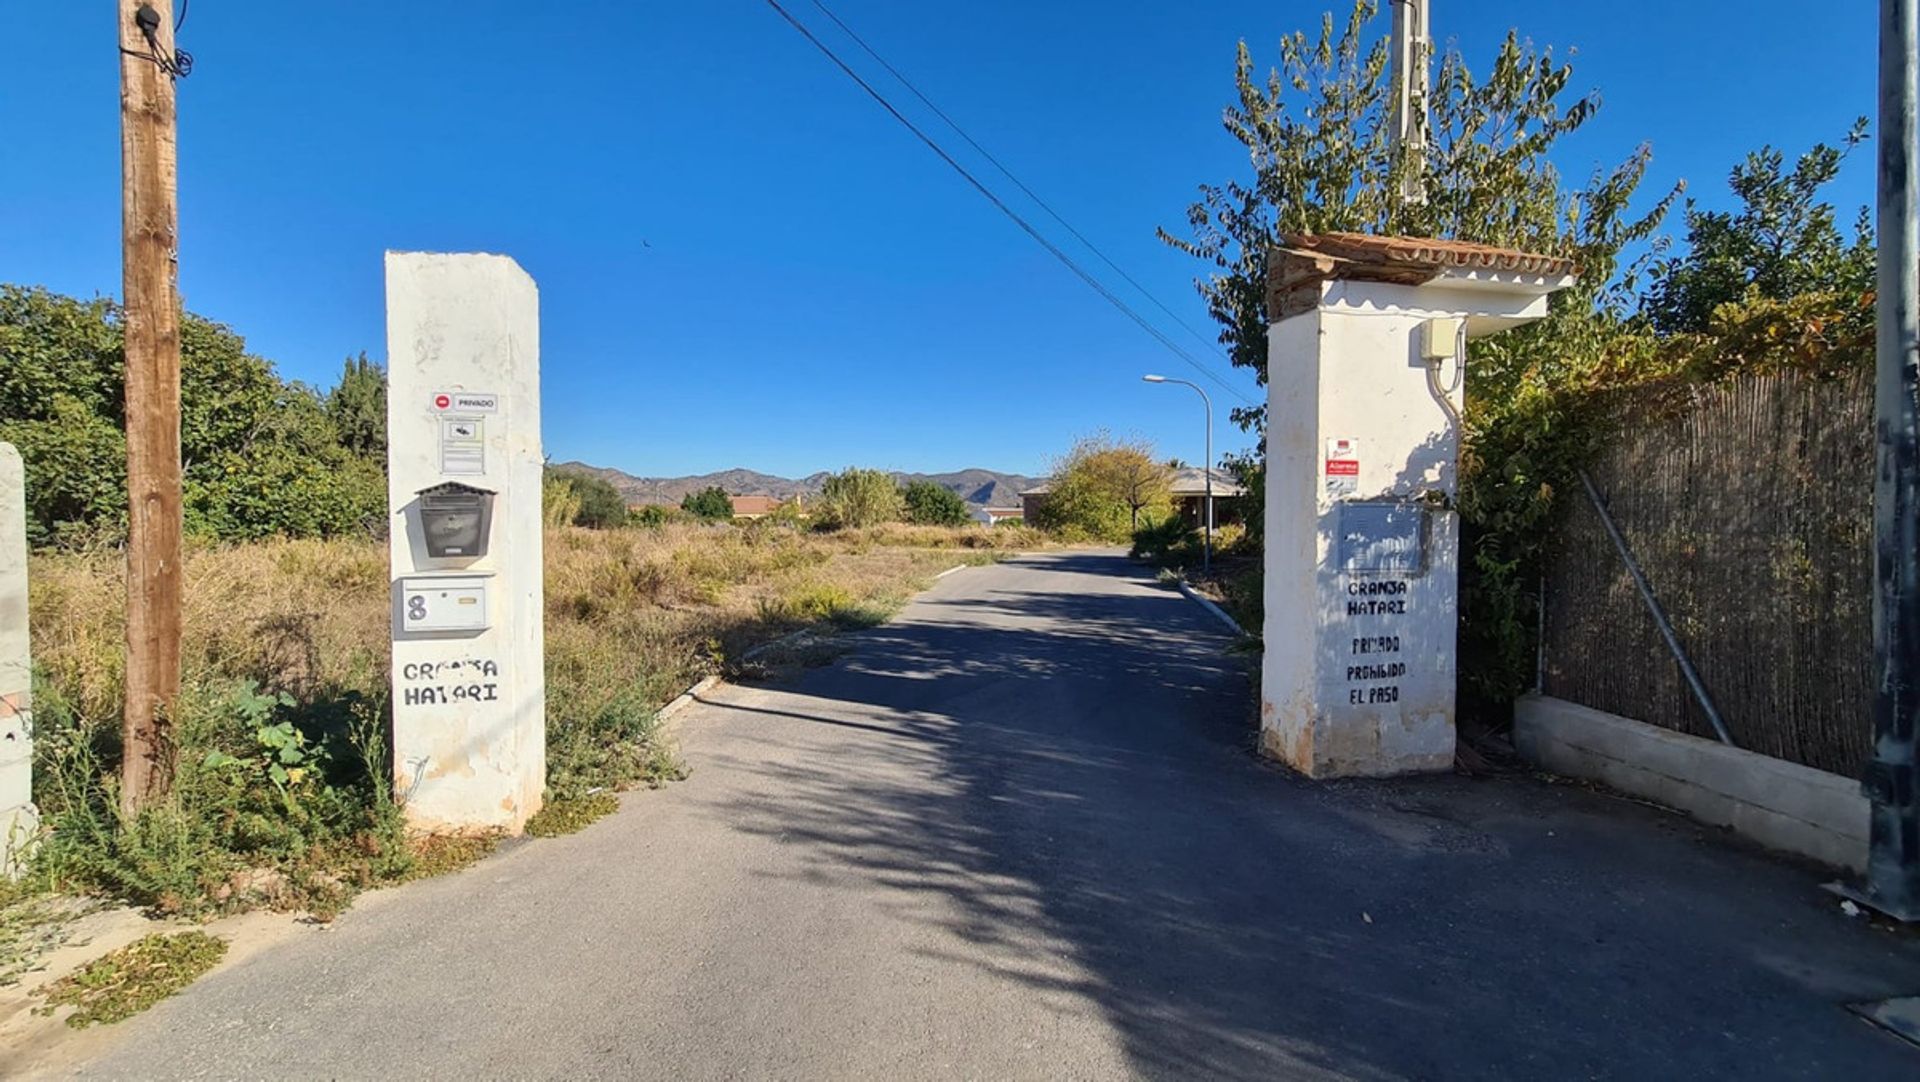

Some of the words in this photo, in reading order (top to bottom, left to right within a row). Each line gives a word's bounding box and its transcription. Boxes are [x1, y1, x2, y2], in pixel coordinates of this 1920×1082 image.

[459, 398, 494, 408] PRIVADO
[1348, 581, 1407, 596] GRANJA
[408, 595, 427, 621] 8
[1347, 600, 1406, 616] HATARI
[1350, 689, 1365, 705] EL
[1369, 686, 1399, 704] PASO
